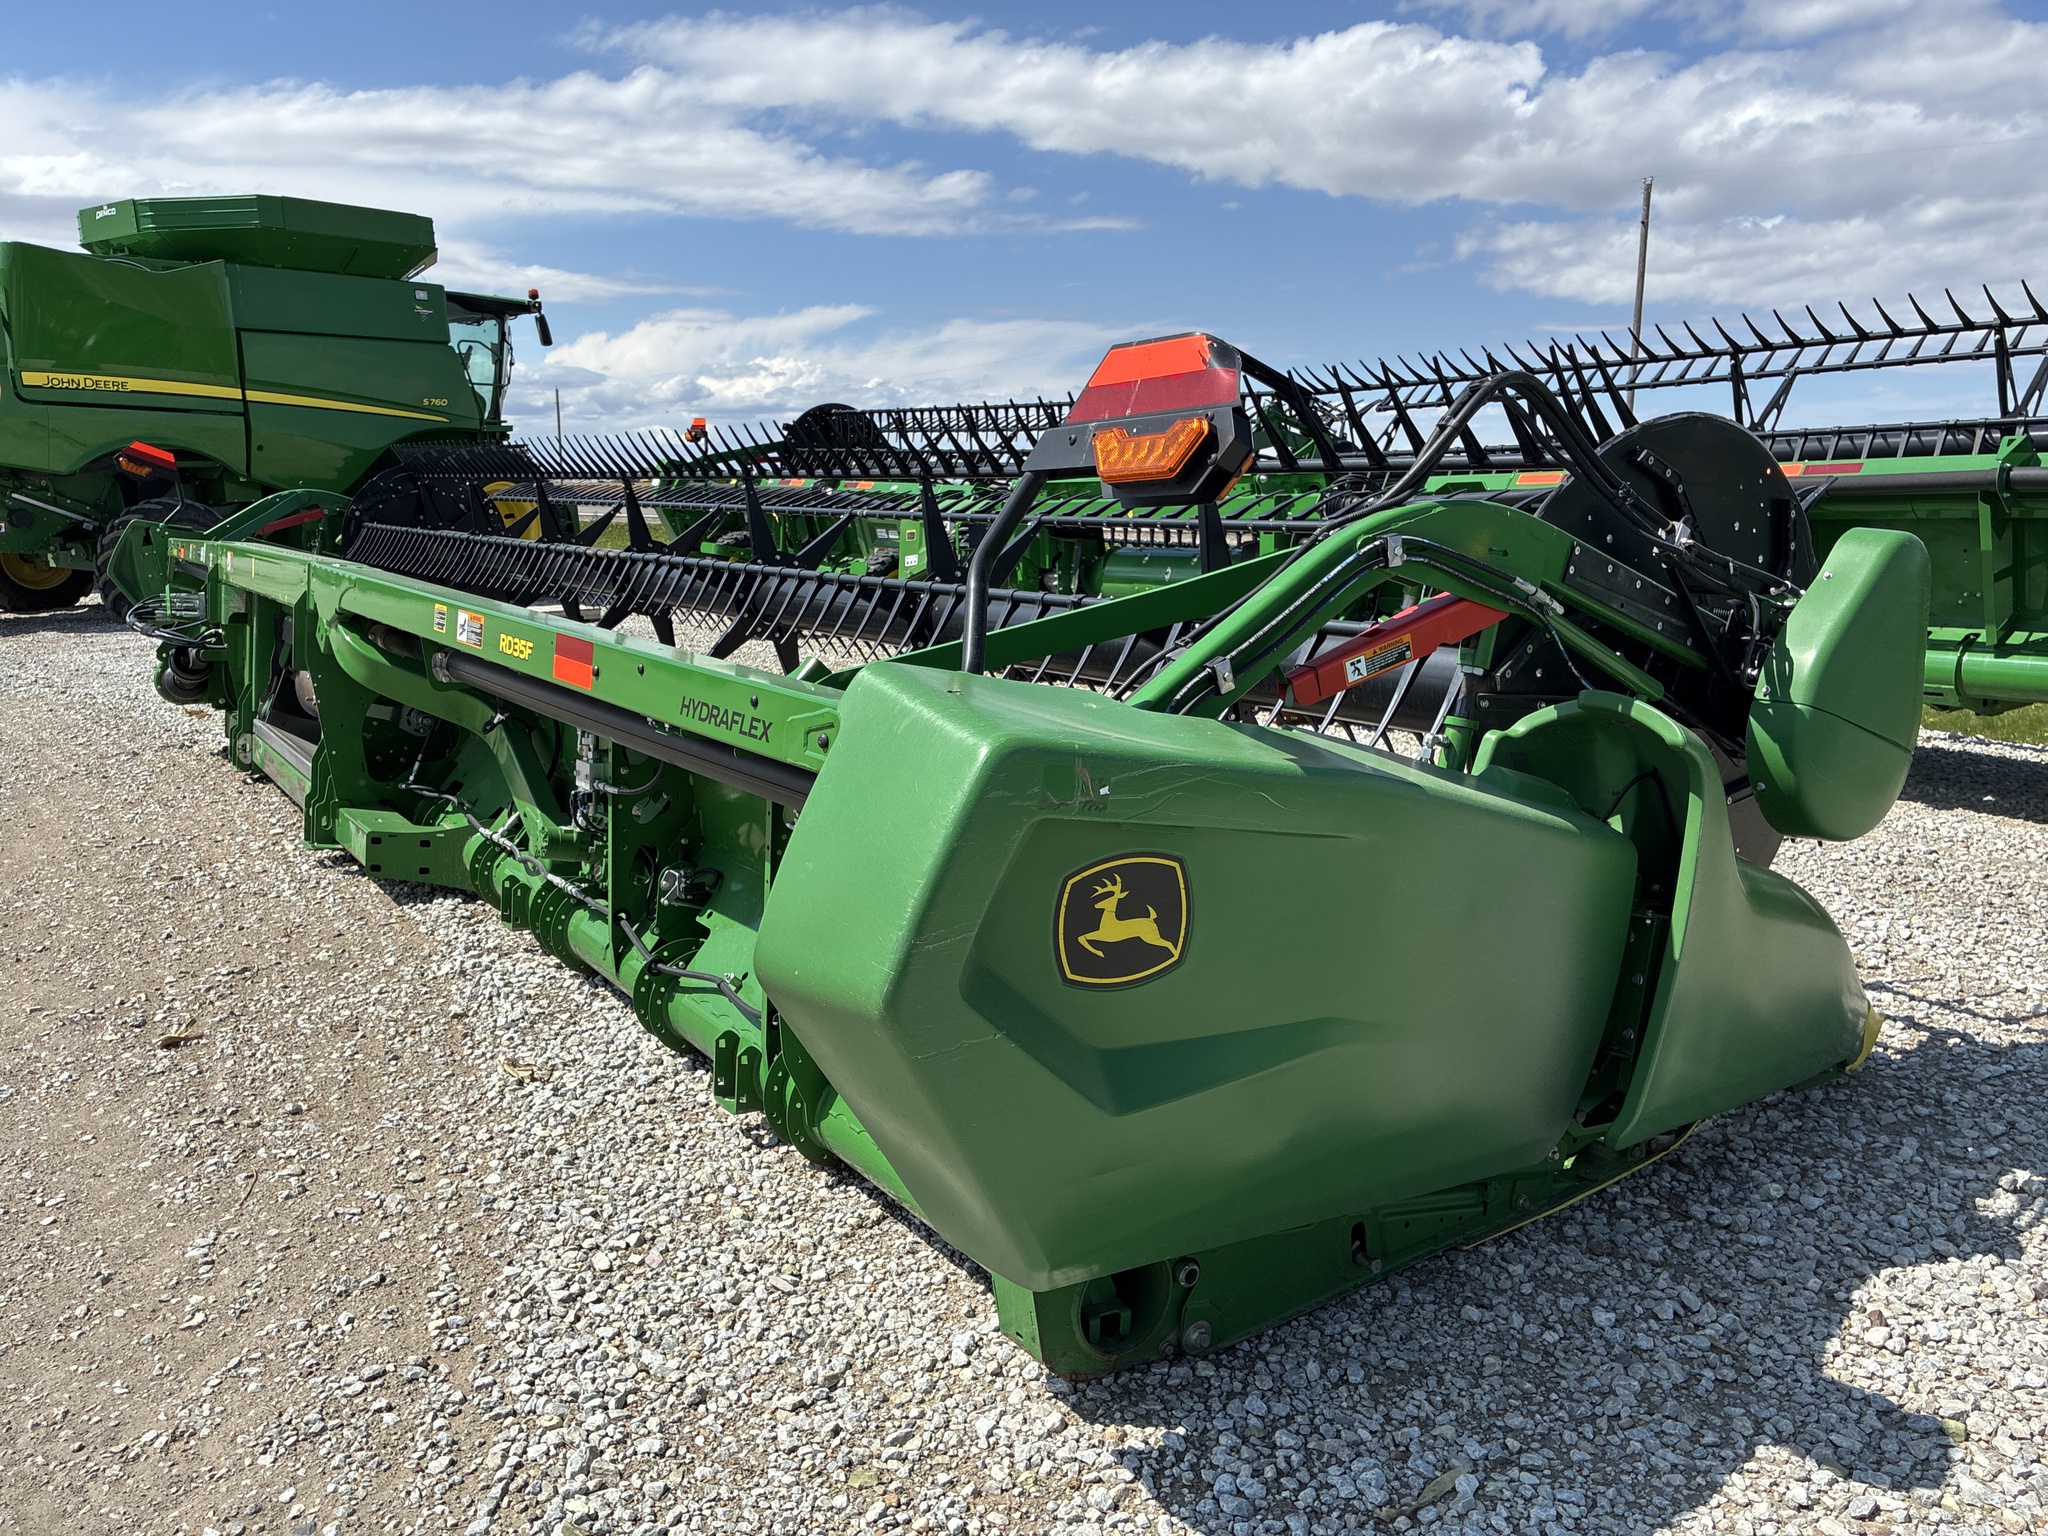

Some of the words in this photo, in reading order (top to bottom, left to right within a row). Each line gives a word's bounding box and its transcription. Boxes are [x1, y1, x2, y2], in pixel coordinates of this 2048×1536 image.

[43, 375, 80, 387] JOHN
[83, 377, 129, 390] DEERE
[499, 633, 534, 661] RD35F
[1378, 638, 1404, 652] WARNING
[679, 696, 774, 743] HYDRAFLEX
